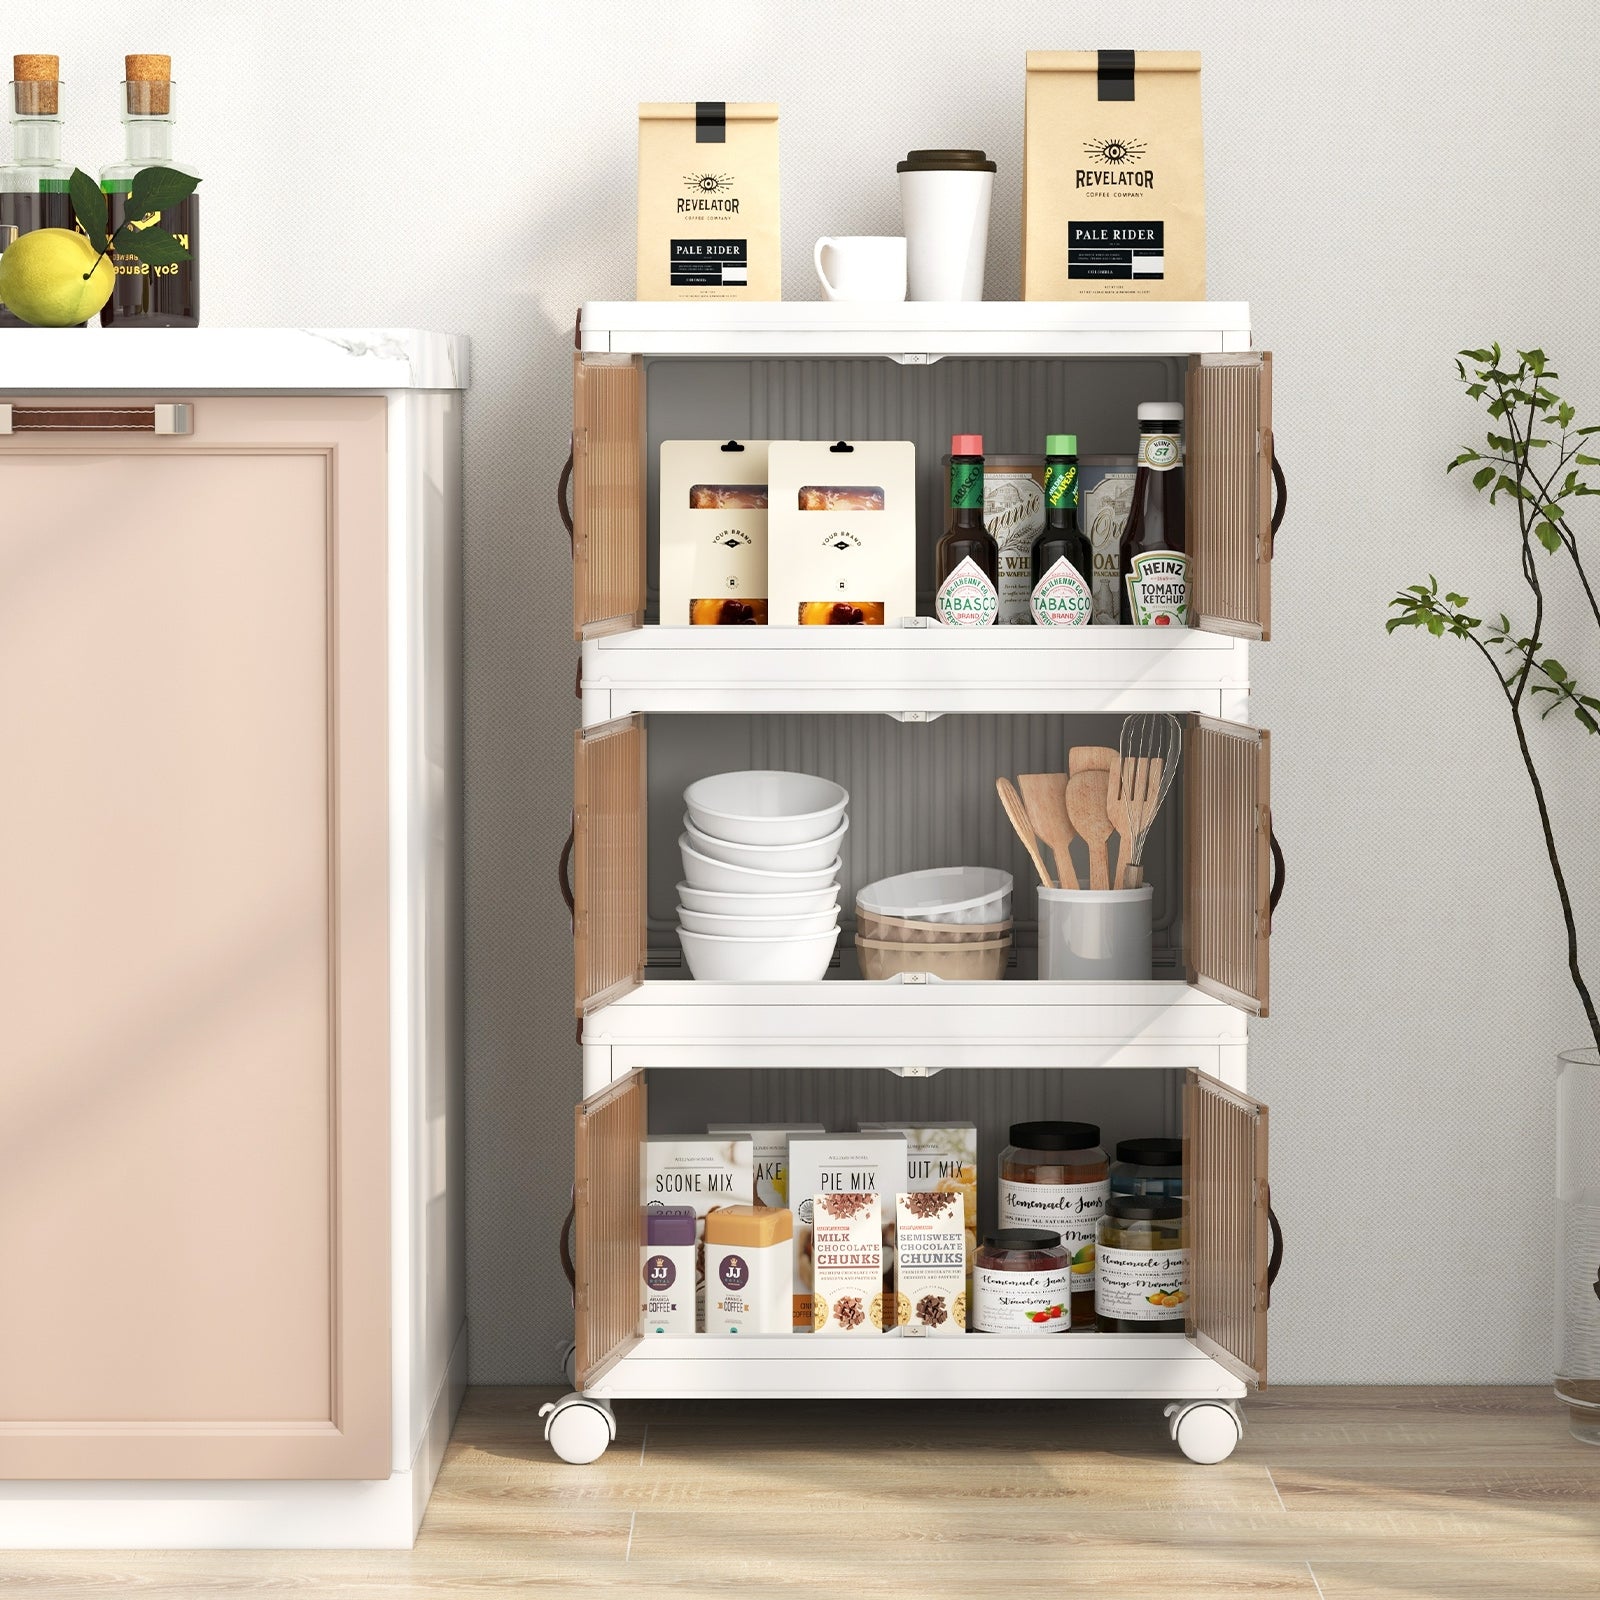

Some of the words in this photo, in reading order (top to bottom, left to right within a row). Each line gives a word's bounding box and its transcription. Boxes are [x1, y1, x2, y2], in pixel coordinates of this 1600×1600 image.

[1076, 170, 1154, 189] REVELATOR
[677, 198, 740, 215] REVELATOR
[1075, 229, 1108, 240] PALE
[1113, 229, 1155, 240] RIDER
[676, 245, 702, 255] PALE
[706, 245, 740, 255] RIDER
[1155, 448, 1169, 456] 57
[953, 467, 980, 506] TABASCO
[712, 529, 729, 545] YOUR
[731, 529, 752, 545] BRAND
[821, 531, 838, 547] YOUR
[841, 531, 862, 547] BRAND
[1142, 562, 1183, 576] HEINZ
[1141, 584, 1186, 595] TOMATO
[938, 597, 996, 611] TABASCO
[1033, 597, 1091, 611] TABASCO
[1143, 595, 1184, 604] KETCHUP
[957, 612, 980, 620] BRAND
[1051, 612, 1074, 620] BRAND
[753, 1162, 783, 1181] AKE
[908, 1160, 931, 1179] UIT
[939, 1160, 963, 1179] MIX
[656, 1173, 702, 1193] SCONE
[708, 1173, 733, 1192] MIX
[821, 1172, 843, 1191] PIE
[851, 1172, 876, 1191] MIX
[1005, 1193, 1072, 1211] Homemade
[1074, 1195, 1104, 1214] Jams
[817, 1233, 850, 1242] MILK
[900, 1233, 963, 1241] SEMISWEET
[1060, 1230, 1096, 1243] Mang
[900, 1243, 963, 1251] CHOCOLATE
[817, 1254, 880, 1265] CHUNKS
[900, 1253, 963, 1264] CHUNKS
[1101, 1254, 1160, 1268] Homemade
[650, 1267, 668, 1279] JJ
[725, 1266, 742, 1278] JJ
[981, 1274, 1040, 1287] Homemade
[999, 1296, 1052, 1305] Strawberry
[648, 1302, 671, 1313] COFFEE
[723, 1301, 744, 1313] COFFEE
